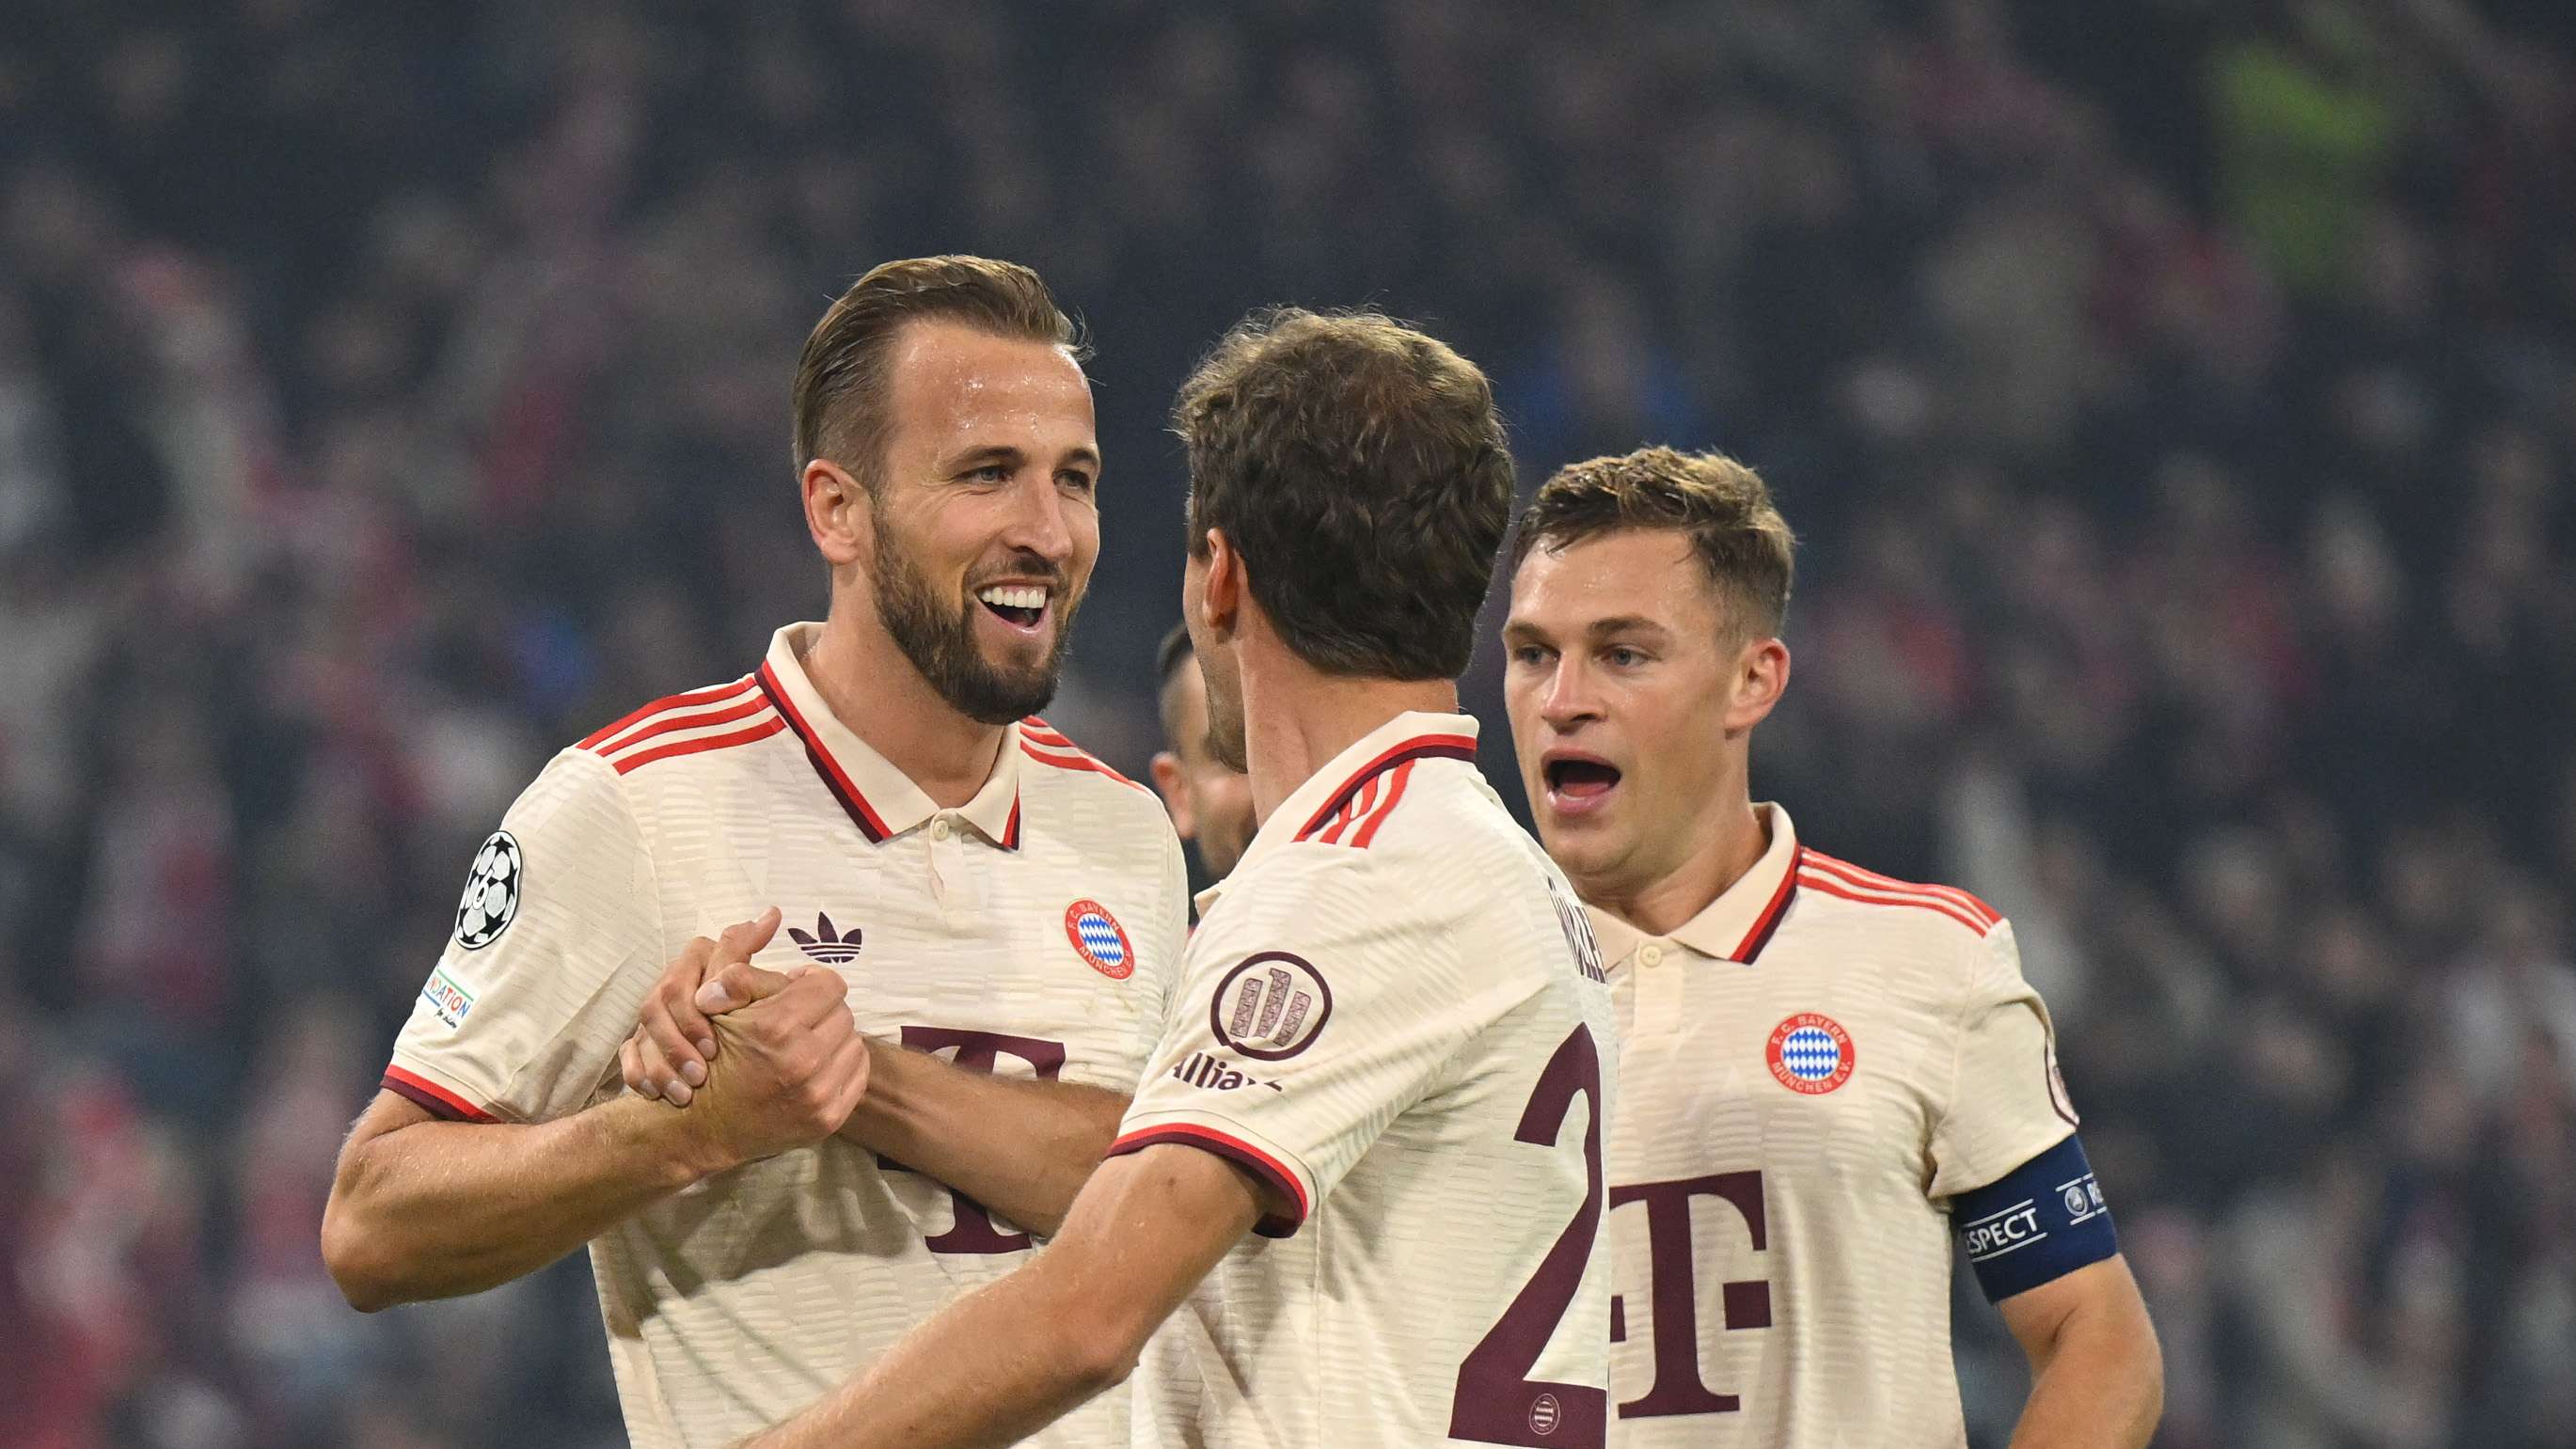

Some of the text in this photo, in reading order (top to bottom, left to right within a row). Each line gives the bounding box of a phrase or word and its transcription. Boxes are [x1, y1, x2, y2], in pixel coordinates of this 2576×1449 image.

[1797, 1016, 1848, 1044] BAYERN
[1965, 1207, 2038, 1254] SPECT
[1609, 1170, 1772, 1420] T
